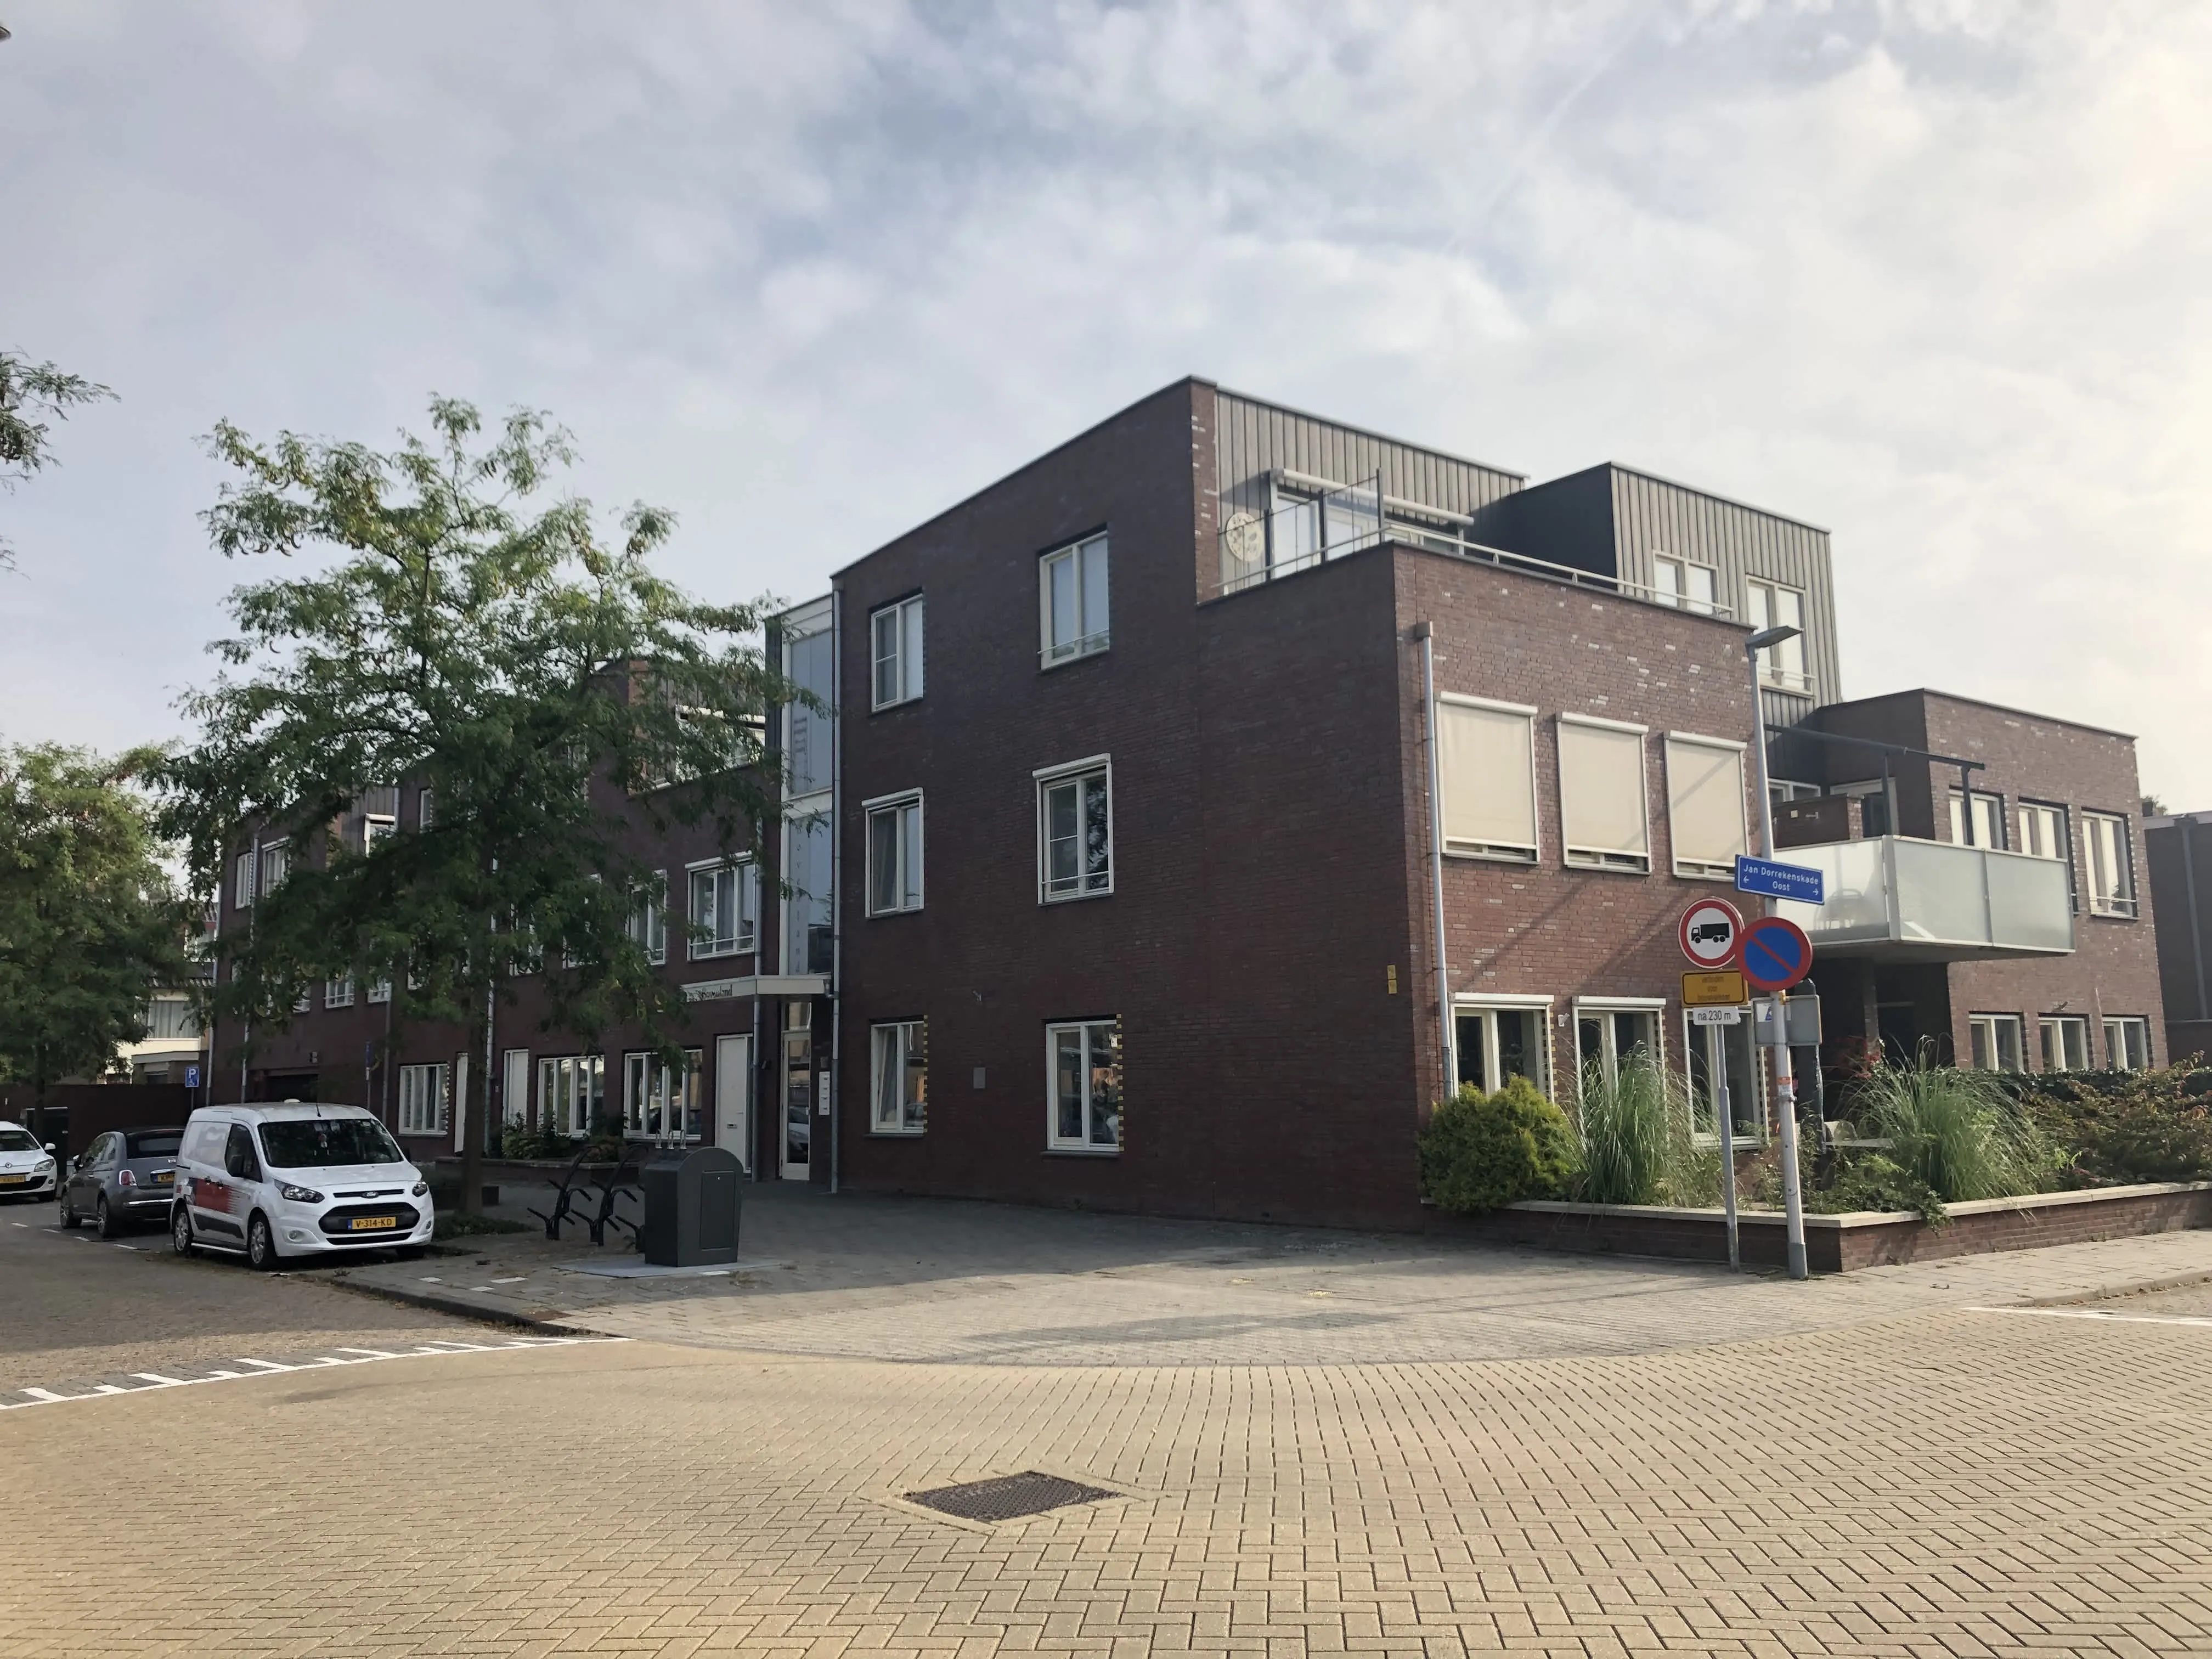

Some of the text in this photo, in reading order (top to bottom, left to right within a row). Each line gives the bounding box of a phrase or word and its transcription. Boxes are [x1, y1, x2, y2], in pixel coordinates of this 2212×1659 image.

[1743, 864, 1819, 885] Jan Dorrekenskade
[1772, 881, 1790, 891] Oost
[1697, 1010, 1731, 1021] na 230 m
[356, 1218, 392, 1228] V-314-KD
